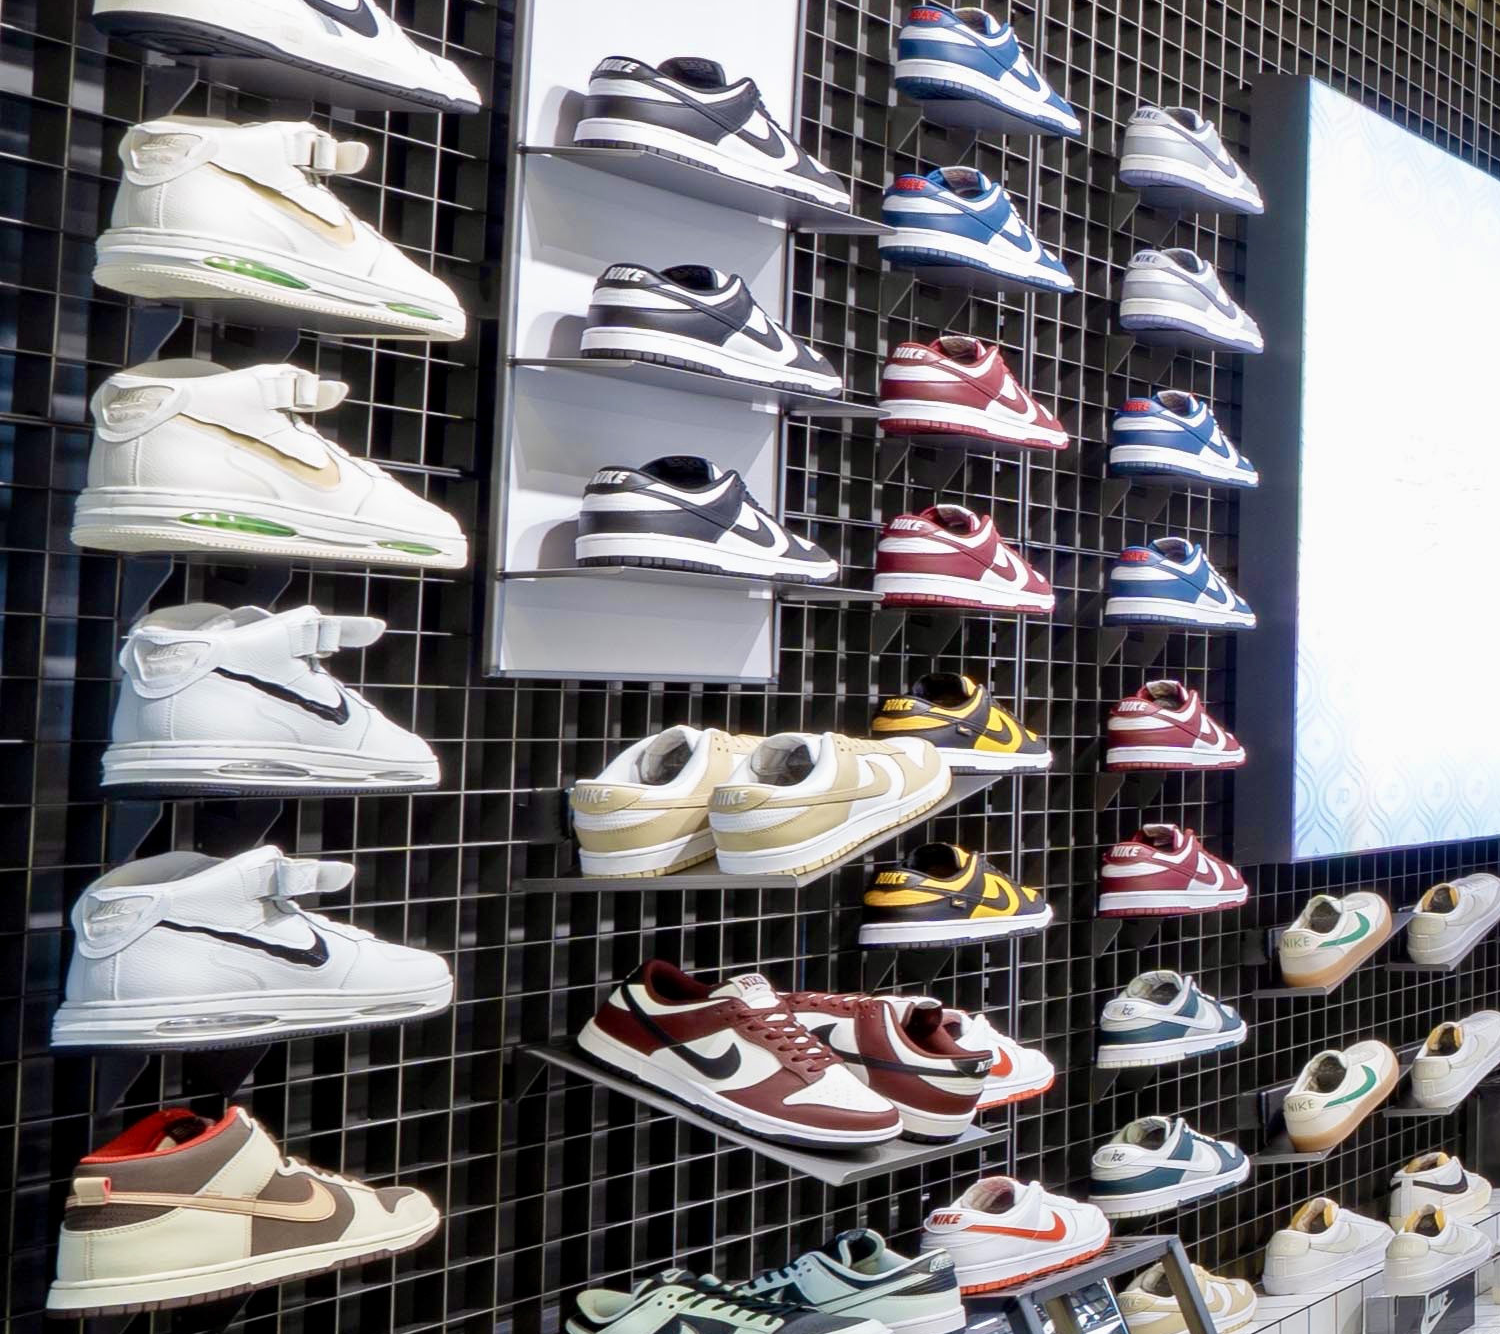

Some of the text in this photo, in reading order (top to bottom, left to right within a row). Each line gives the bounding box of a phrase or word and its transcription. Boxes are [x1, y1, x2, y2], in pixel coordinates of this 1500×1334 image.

[603, 266, 648, 283] NIKE
[892, 347, 928, 360] NIKE
[890, 518, 923, 531] NIKE
[883, 698, 916, 711] NIKE
[1118, 700, 1149, 712] NIKE
[576, 787, 612, 804] NIKE
[715, 789, 748, 805] NIKE
[1112, 845, 1140, 857] NIKE
[876, 871, 910, 885] NIKE
[1282, 936, 1311, 949] NIKE
[1287, 1099, 1315, 1113] NIKE
[930, 1213, 963, 1225] NIKE
